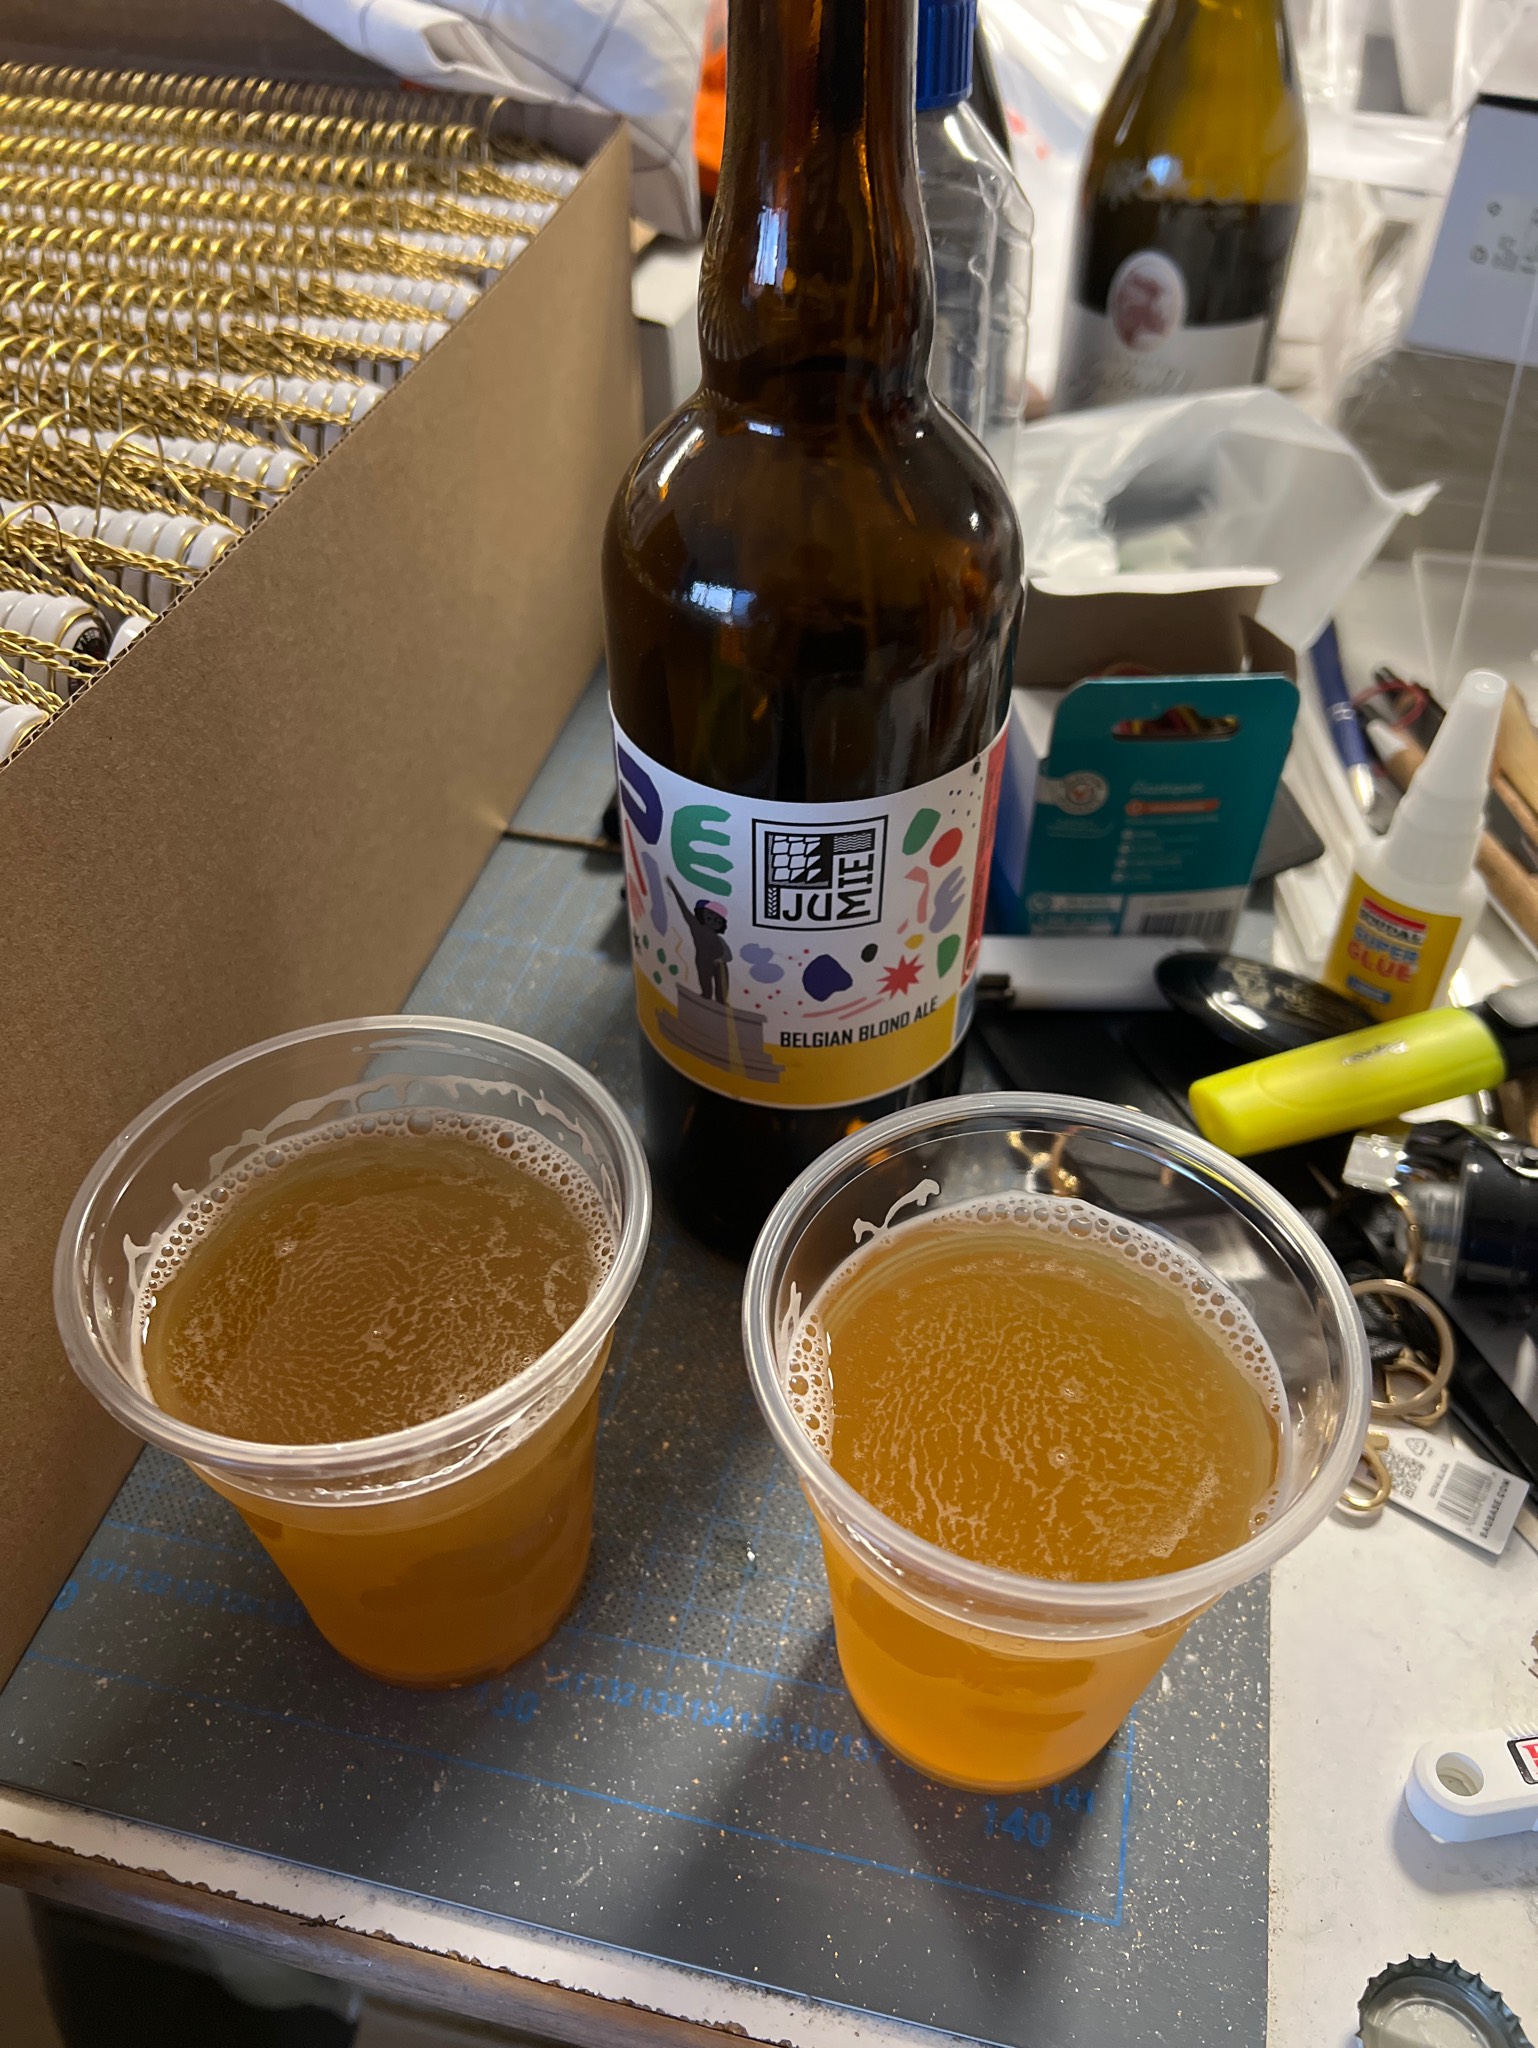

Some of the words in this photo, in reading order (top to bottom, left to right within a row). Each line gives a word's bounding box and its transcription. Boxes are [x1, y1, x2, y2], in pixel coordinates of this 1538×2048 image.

[1347, 939, 1412, 984] GLUE
[780, 1029, 853, 1048] BELGIAN
[859, 1010, 910, 1042] BLOND
[914, 995, 939, 1023] ALE
[640, 1687, 688, 1719] 133
[690, 1698, 734, 1730] 134
[790, 1721, 837, 1755] 136
[983, 1799, 1052, 1849] 140
[1049, 1783, 1096, 1817] 141
